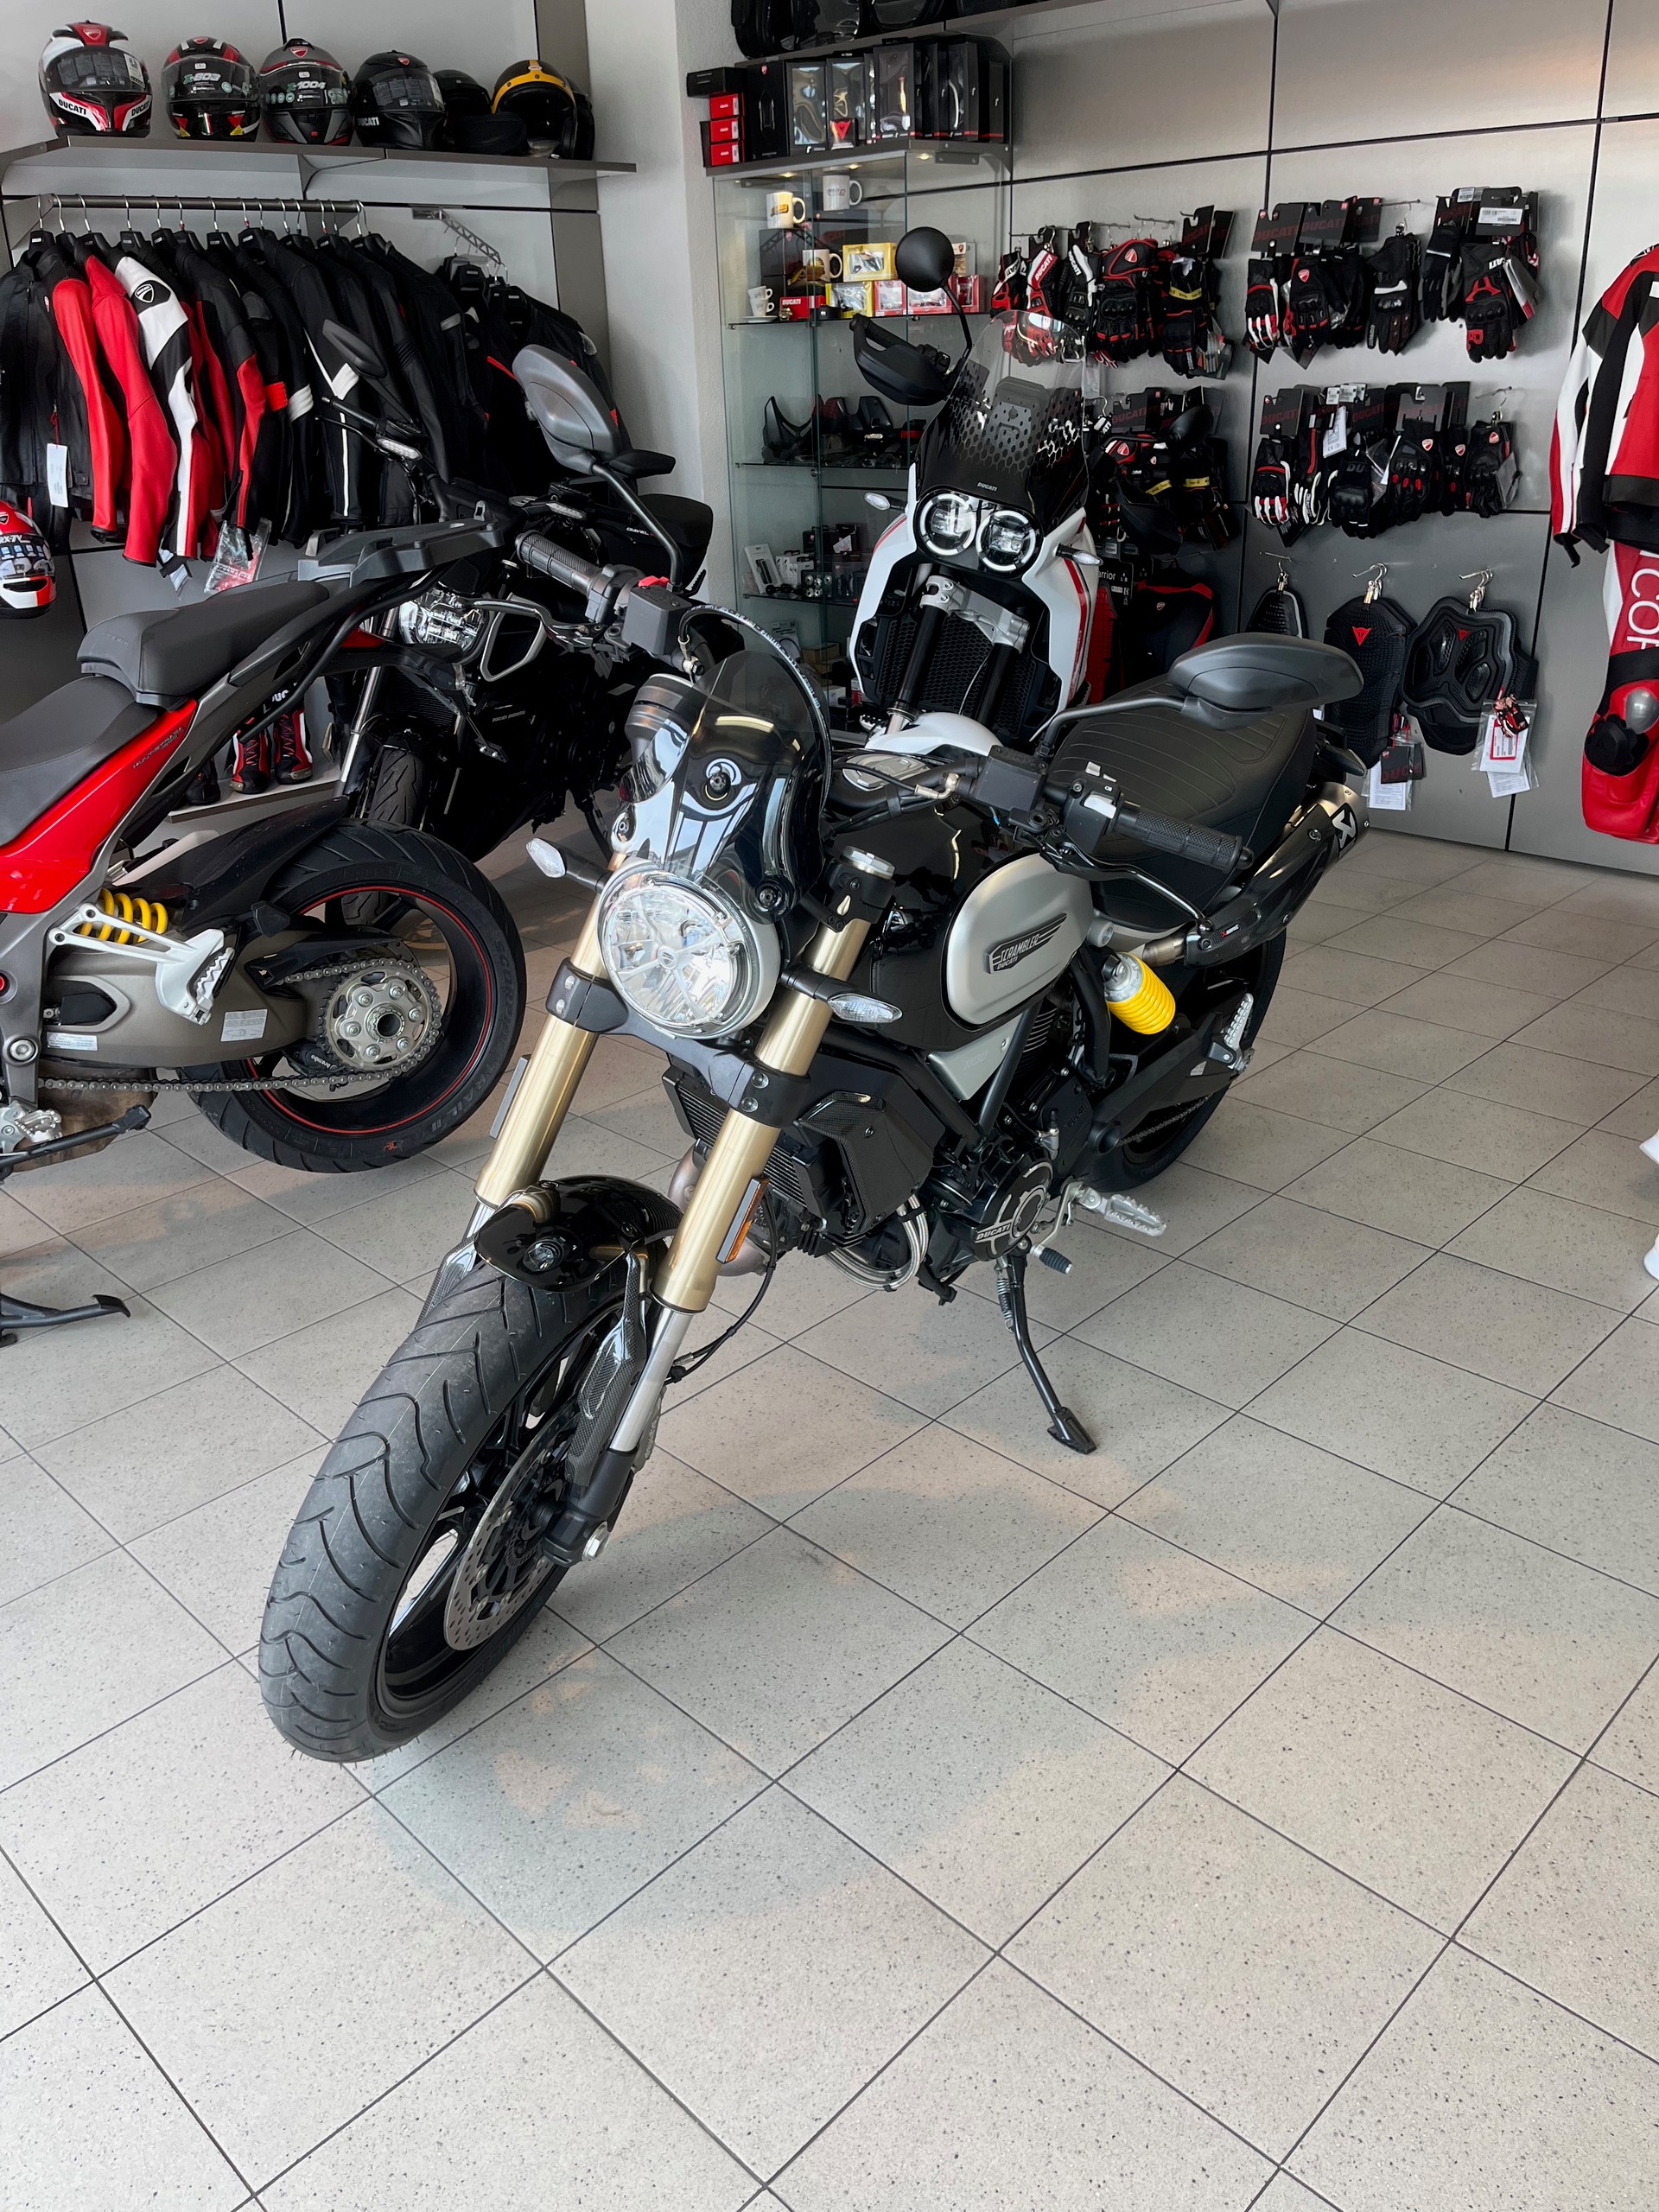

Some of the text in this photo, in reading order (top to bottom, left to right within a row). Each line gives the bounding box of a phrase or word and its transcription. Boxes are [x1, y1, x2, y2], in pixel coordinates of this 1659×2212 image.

[286, 80, 326, 92] X-1004
[58, 99, 87, 116] DUCATI
[130, 101, 151, 118] DUCATI
[1253, 223, 1298, 243] DUCATI
[1300, 216, 1346, 233] DUCATI
[1034, 253, 1053, 282] DUCATI
[1111, 406, 1147, 424] DUCATI
[1259, 408, 1300, 426] DUCATI
[976, 481, 998, 493] DUCATI
[999, 933, 1040, 963] SCRAMBLER
[996, 955, 1019, 970] DUCATI
[311, 1055, 331, 1068] brembo
[1066, 1103, 1087, 1128] DUCATI
[976, 1224, 1011, 1240] DUCATI
